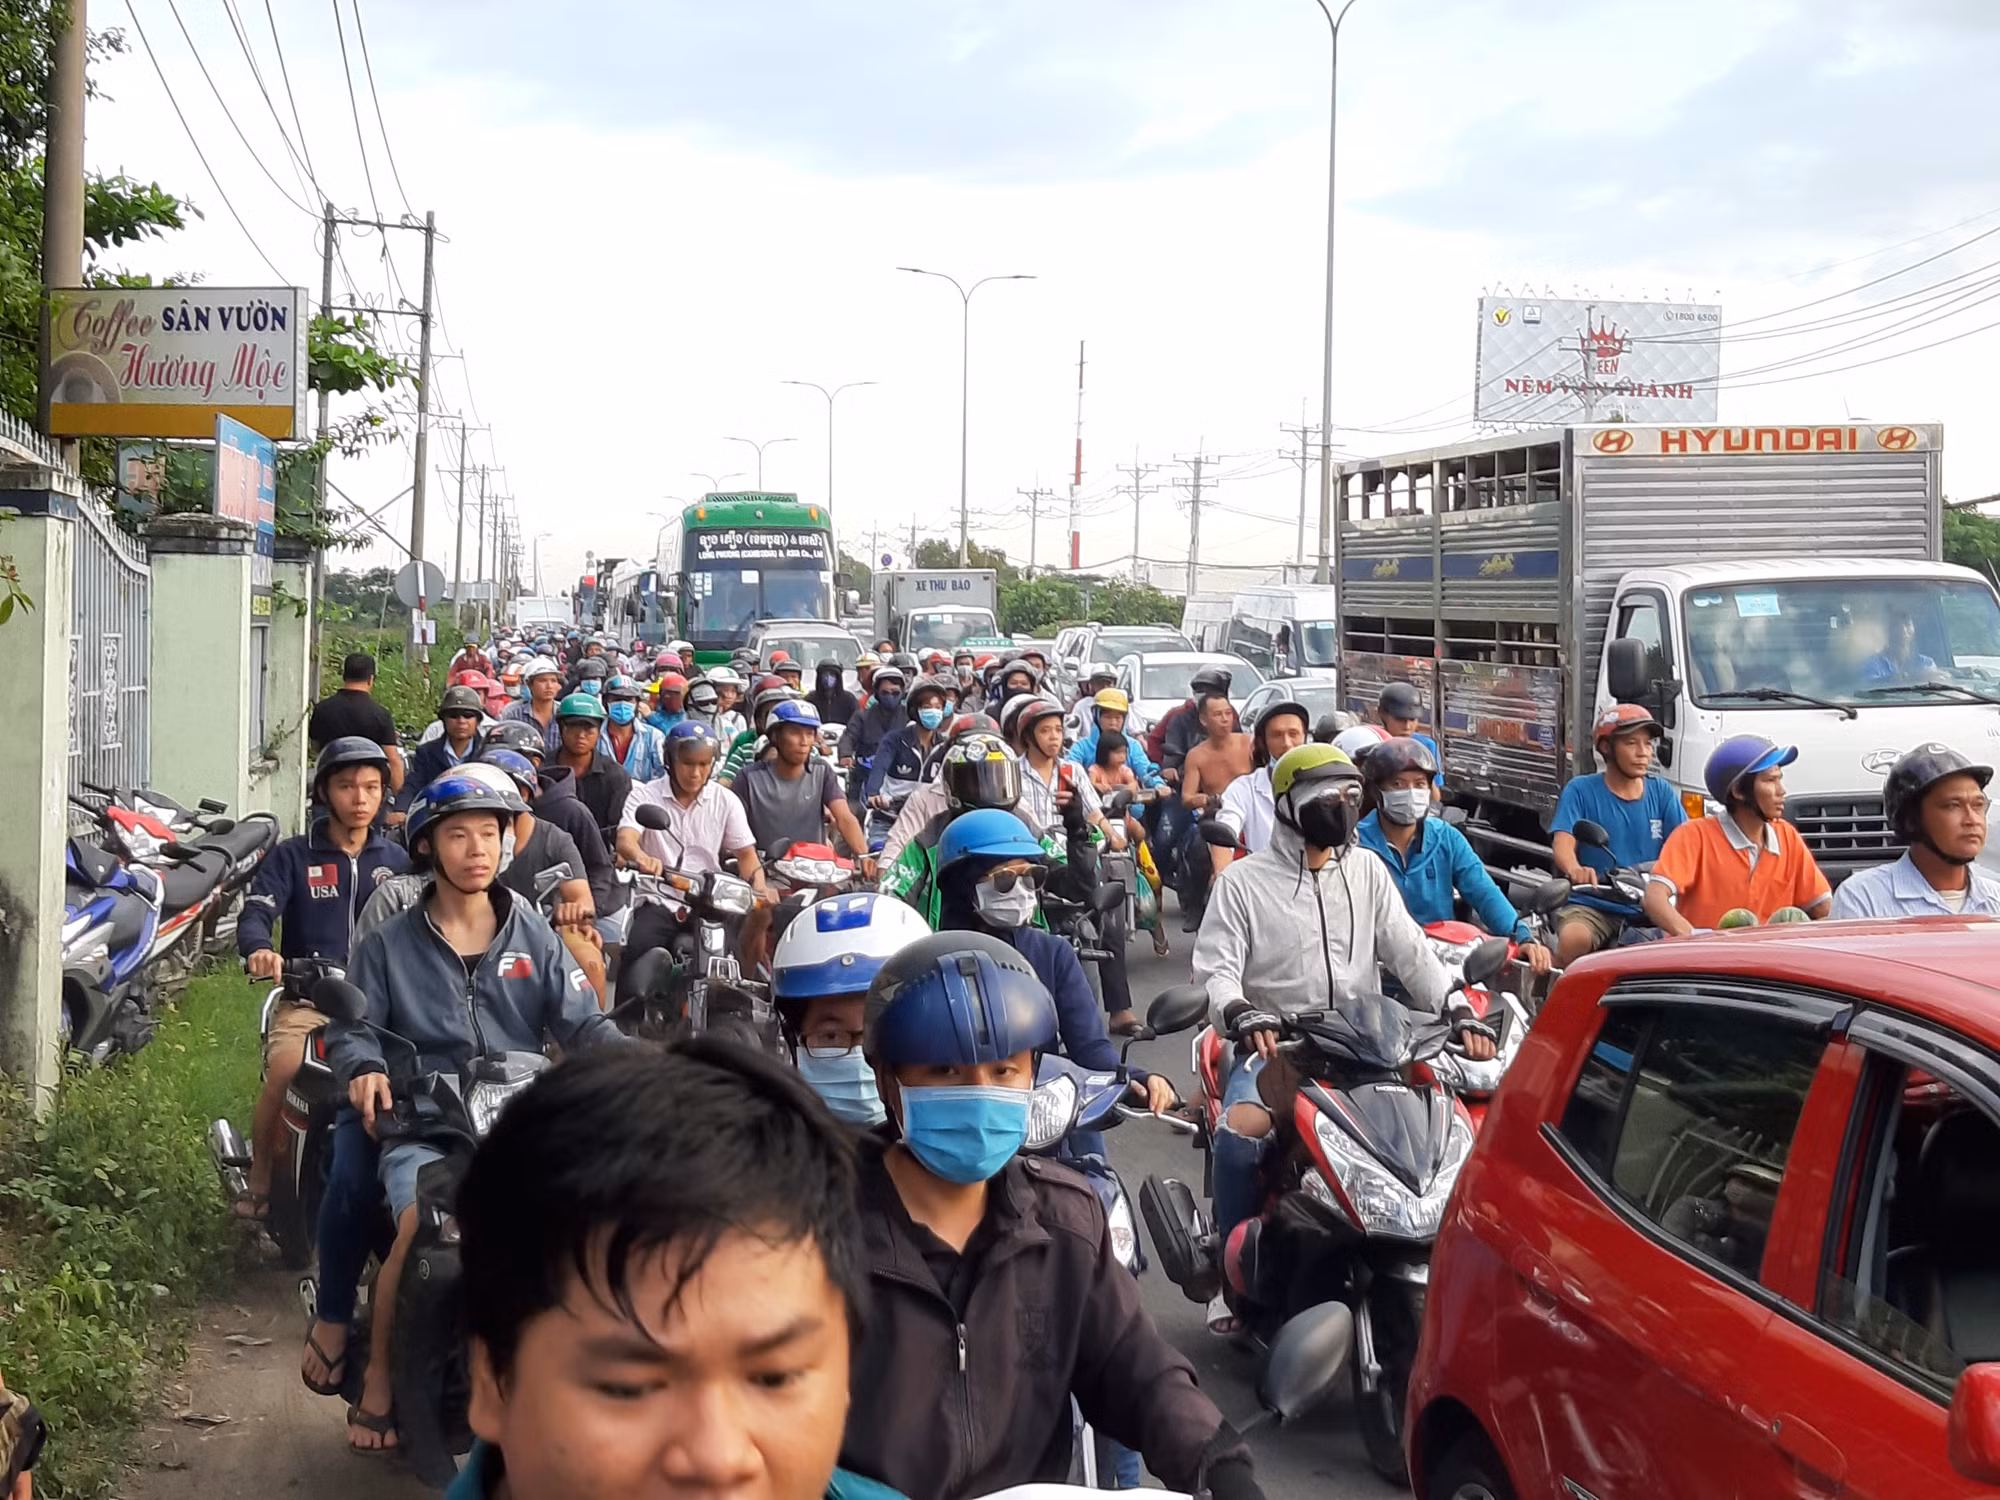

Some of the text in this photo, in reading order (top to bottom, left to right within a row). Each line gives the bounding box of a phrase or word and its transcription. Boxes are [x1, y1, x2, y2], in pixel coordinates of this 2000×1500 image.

[58, 298, 288, 355] Coffee SÂN VƯỜN
[120, 342, 287, 400] Hương Mộc
[1504, 375, 1552, 397] NỆM
[1661, 427, 1857, 453] HYUNDAI
[915, 580, 927, 591] XE
[310, 885, 340, 899] USA
